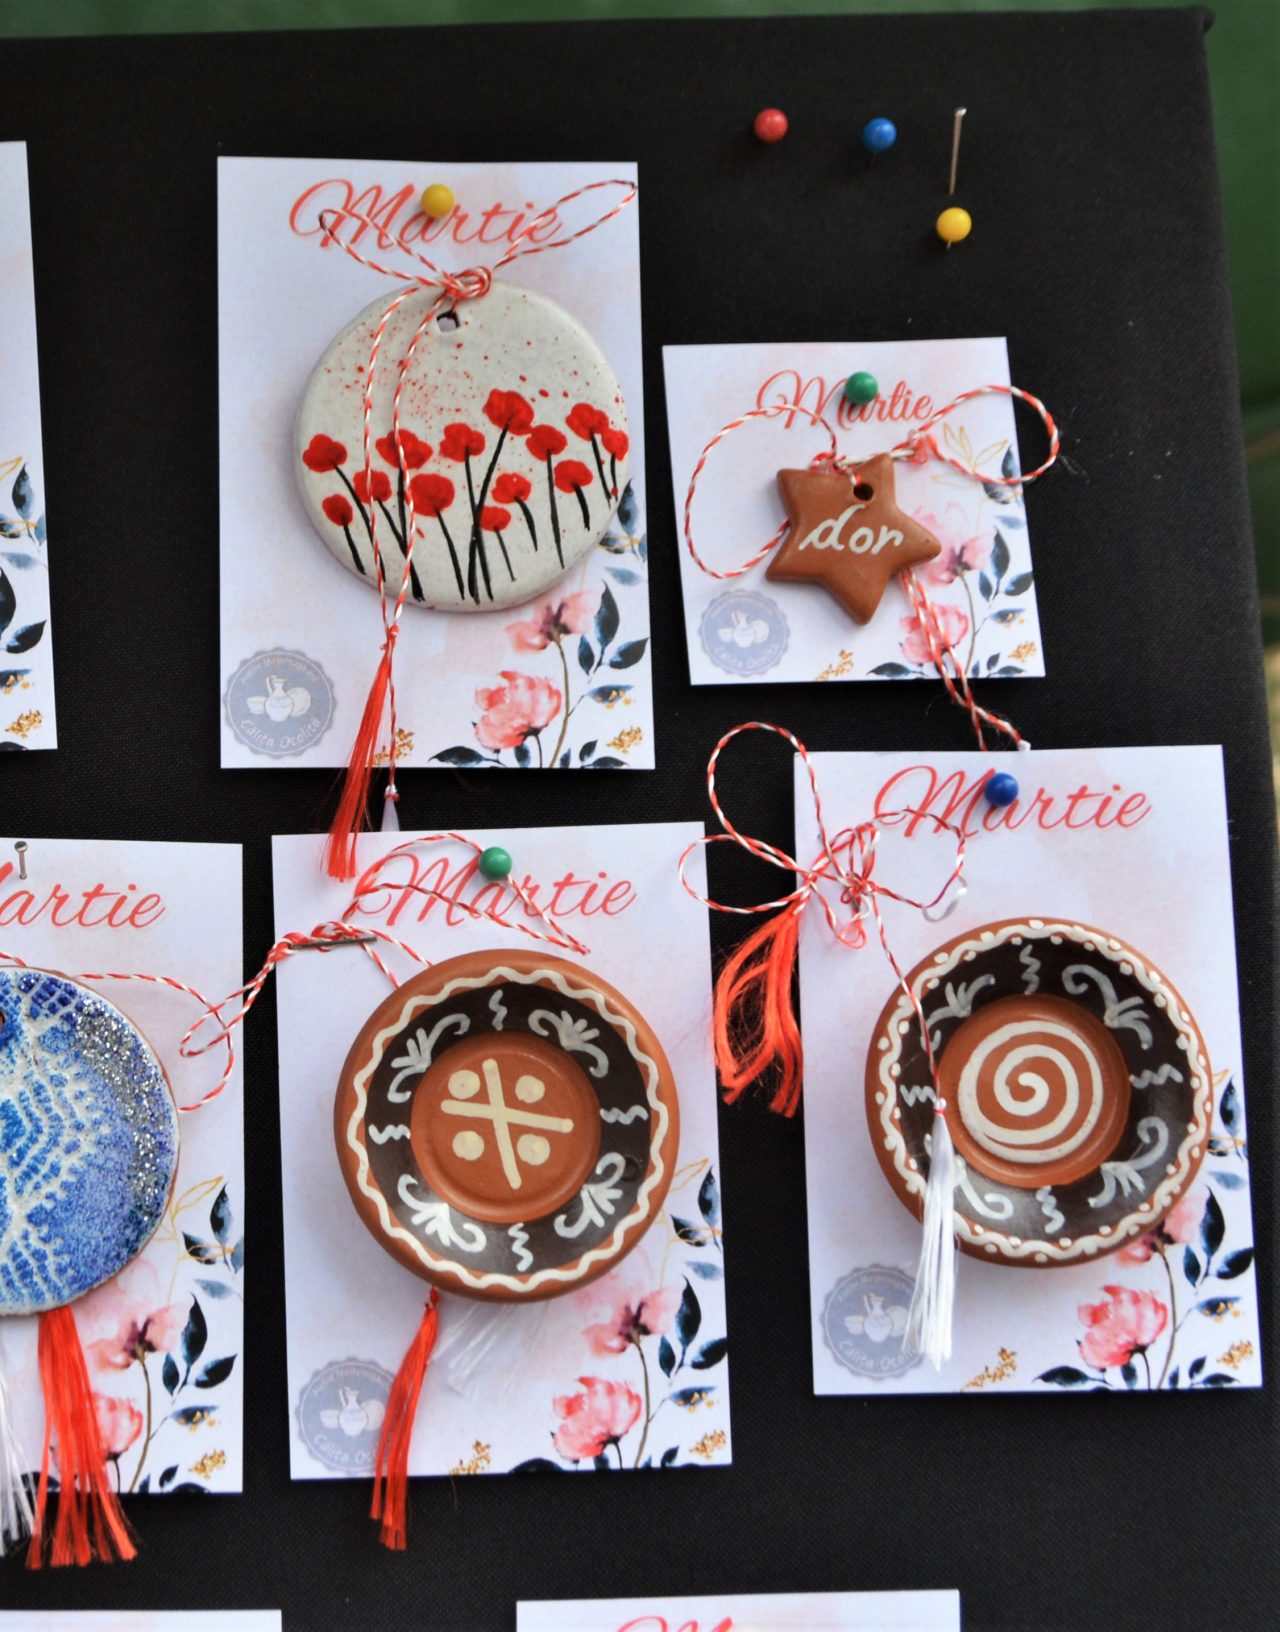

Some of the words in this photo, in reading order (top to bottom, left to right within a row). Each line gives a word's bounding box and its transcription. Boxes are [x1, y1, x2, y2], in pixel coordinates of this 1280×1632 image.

[289, 178, 563, 250] Martie
[756, 369, 933, 431] Martie
[798, 504, 904, 555] dor
[873, 765, 1151, 838] Martie
[354, 853, 637, 926] Martie
